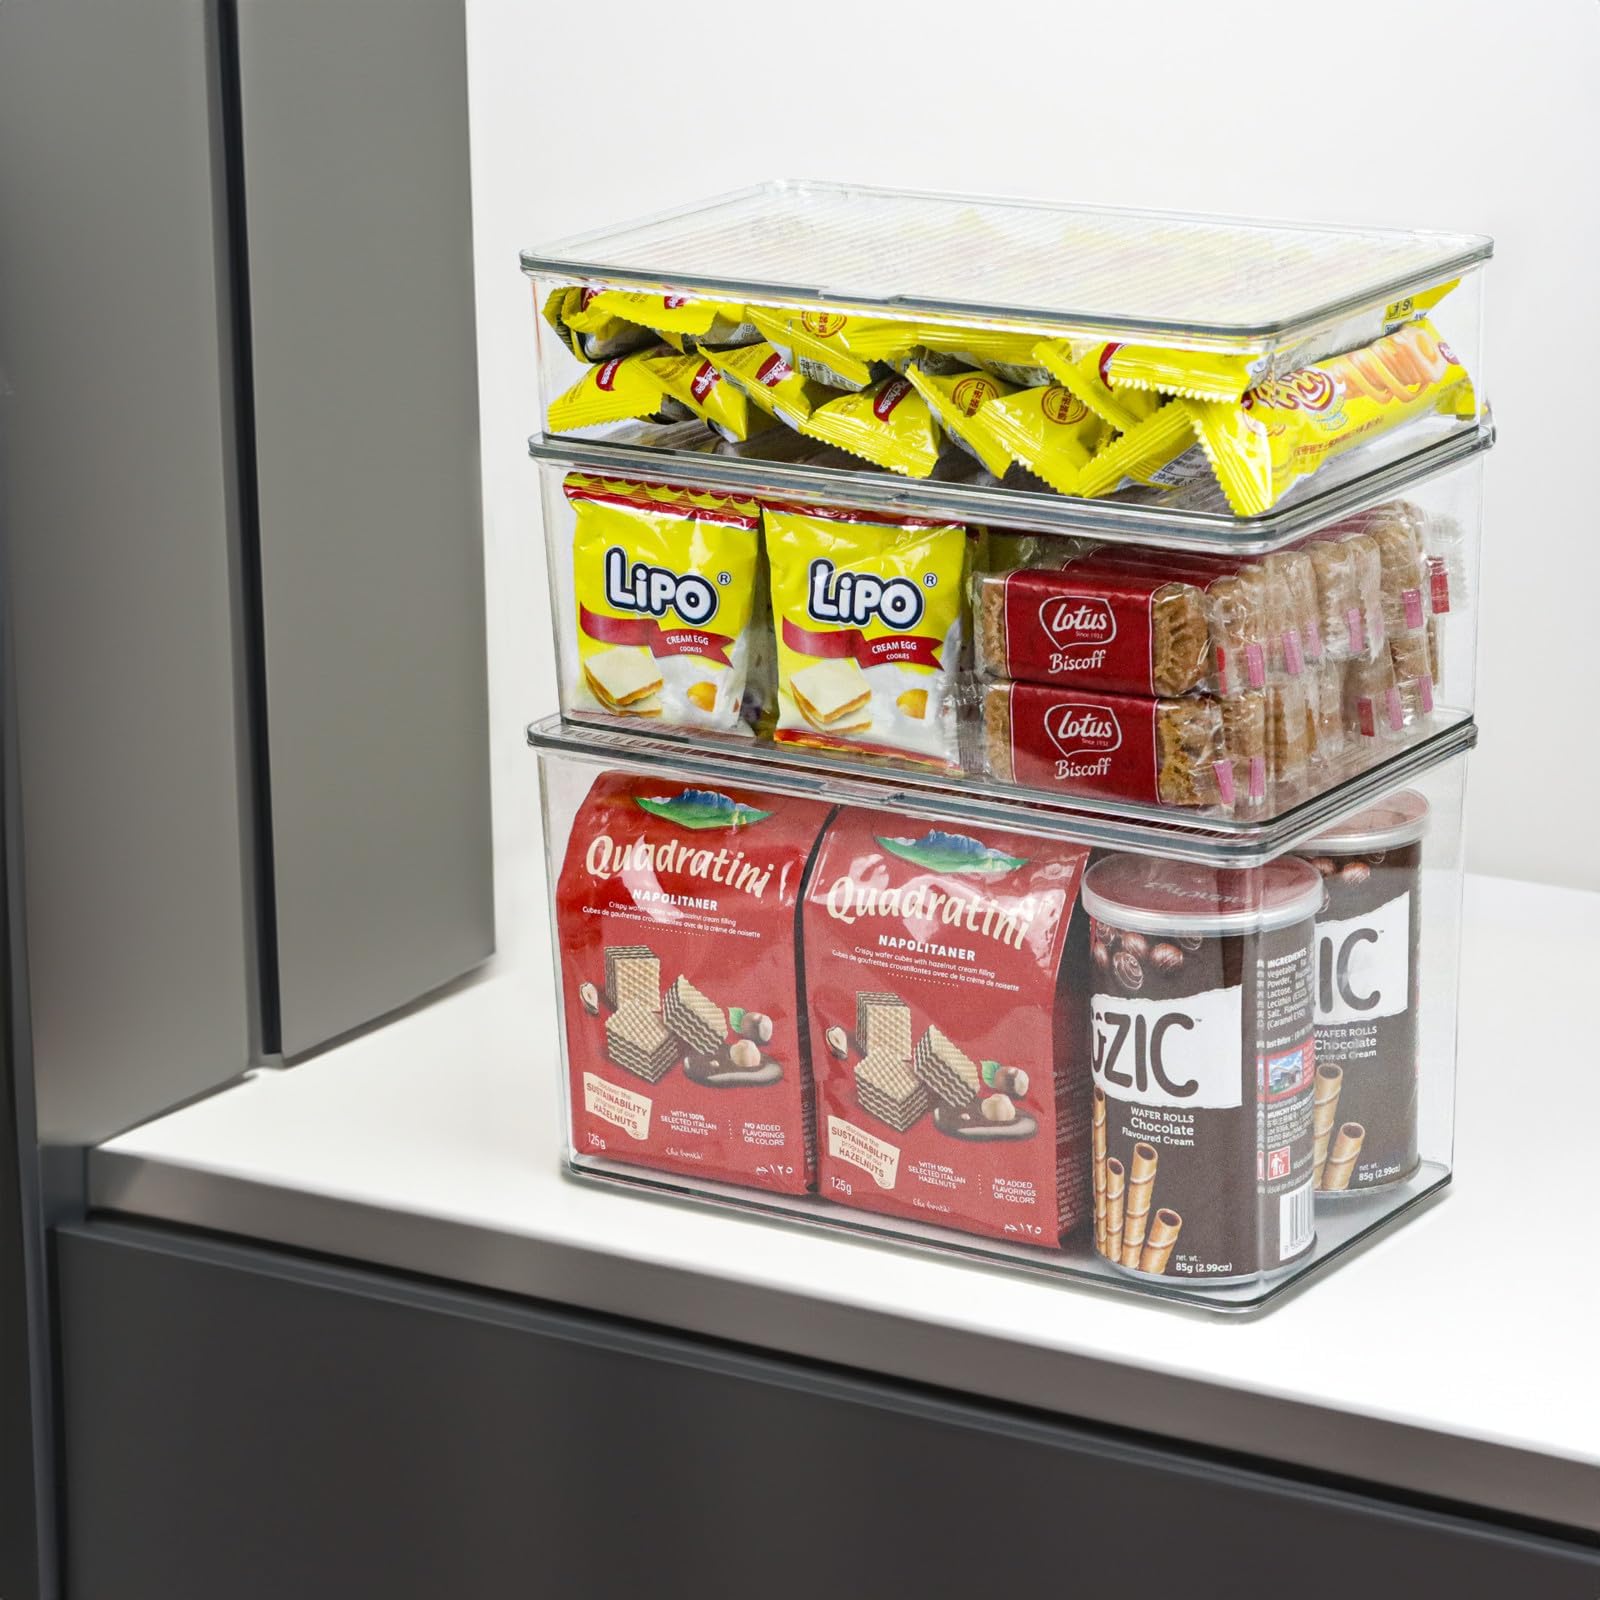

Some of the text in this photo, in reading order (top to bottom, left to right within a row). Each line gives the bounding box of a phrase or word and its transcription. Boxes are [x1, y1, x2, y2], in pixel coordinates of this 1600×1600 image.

[1052, 603, 1108, 632] Lotus
[666, 635, 709, 646] CREAM EGG
[871, 640, 917, 655] CREAM EGG
[886, 652, 910, 660] COOKIES
[1048, 649, 1106, 674] Biscoff
[1058, 710, 1112, 739] Lotus
[1054, 757, 1112, 780] Biscoff
[585, 835, 774, 899] Quadratini
[633, 889, 718, 912] NAPOLITANER
[582, 906, 601, 915] Cubes
[610, 911, 641, 920] gaufrettes
[683, 921, 697, 929] avec
[737, 930, 761, 938] noisette
[608, 901, 628, 911] Crispy
[720, 917, 737, 927] filling
[827, 877, 1034, 950] Quadratini
[879, 934, 976, 961] NAPOLITANER
[832, 949, 849, 959] Cubes
[857, 956, 889, 968] gaufrettes
[889, 962, 931, 975] croustillantes
[932, 970, 949, 978] avec
[949, 972, 958, 980] de
[986, 979, 994, 987] de
[995, 982, 1020, 991] noisette
[854, 946, 995, 979] Crispy wafer cubes with hazelnut cream filling
[1314, 1029, 1347, 1038] WAFER
[1349, 1026, 1377, 1036] ROLLS
[1314, 1038, 1377, 1050] Chocolate
[1348, 1050, 1377, 1060] Cream
[586, 1083, 647, 1116] SUSTAINABILITY
[593, 1103, 638, 1129] HAZELNUTS
[660, 1115, 717, 1130] SELECTED ITALIAN
[671, 1110, 705, 1120] WITH 100%
[1131, 1106, 1194, 1123] WAFER ROLLS
[671, 1125, 708, 1136] HAZELNUTS
[742, 1128, 785, 1139] FLAVORINGS
[756, 1123, 780, 1131] ADDED
[1131, 1117, 1194, 1136] Chocolate
[588, 1132, 606, 1150] 125g
[755, 1137, 784, 1146] COLORS
[1122, 1126, 1195, 1146] Flavoured Cream
[831, 1126, 895, 1165] SUSTAINABILITY
[839, 1147, 884, 1177] HAZELNUTS
[918, 1160, 954, 1174] WITH 100%
[908, 1165, 966, 1184] SELECTED ITALIAN
[918, 1175, 957, 1189] HAZELNUTS
[1359, 1172, 1374, 1181] 85g
[831, 1176, 852, 1195] 125g
[992, 1184, 1037, 1197] FLAVORINGS
[1007, 1179, 1033, 1189] ADDED
[993, 1192, 1035, 1204] OR COLORS
[1175, 1261, 1232, 1274] 85g (2.99oz)
